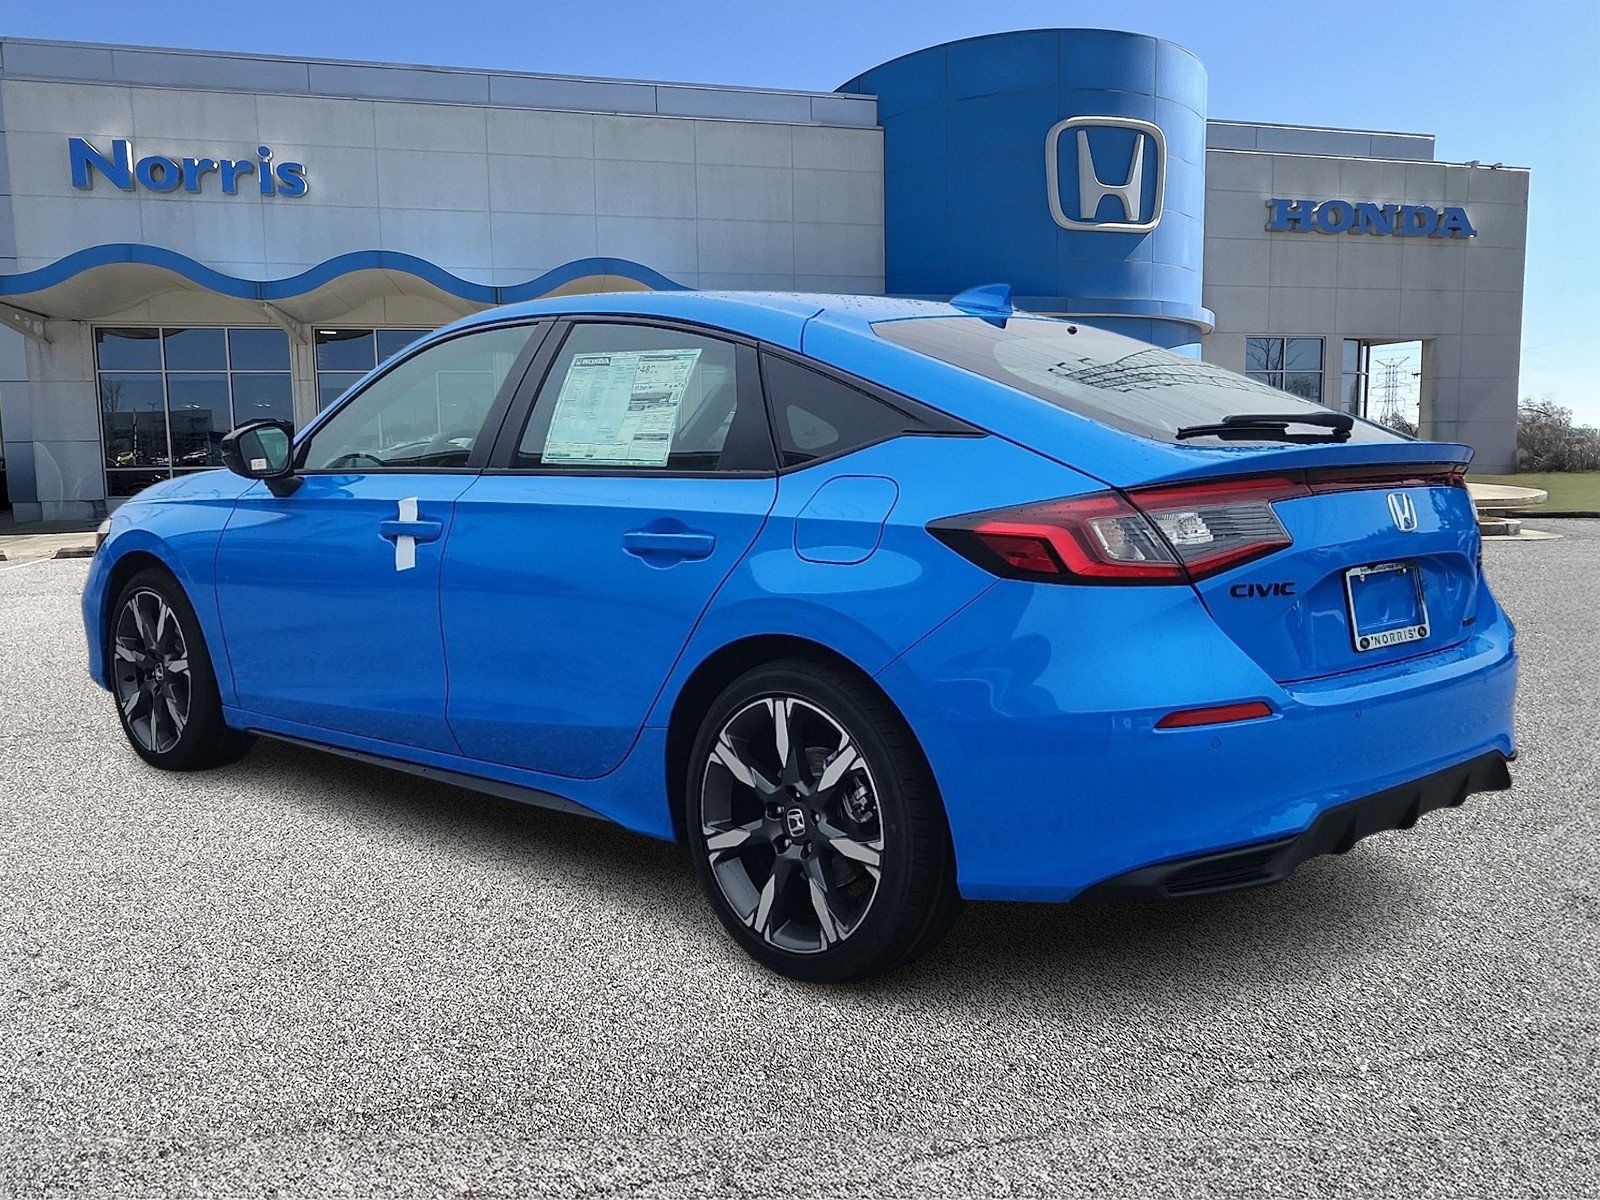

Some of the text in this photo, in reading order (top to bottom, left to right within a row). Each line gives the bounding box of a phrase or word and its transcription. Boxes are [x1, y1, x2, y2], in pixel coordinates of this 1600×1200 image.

[68, 137, 308, 198] Norris
[1265, 198, 1478, 239] HONDA
[581, 357, 610, 366] HONDA
[1229, 581, 1296, 598] CIVIC
